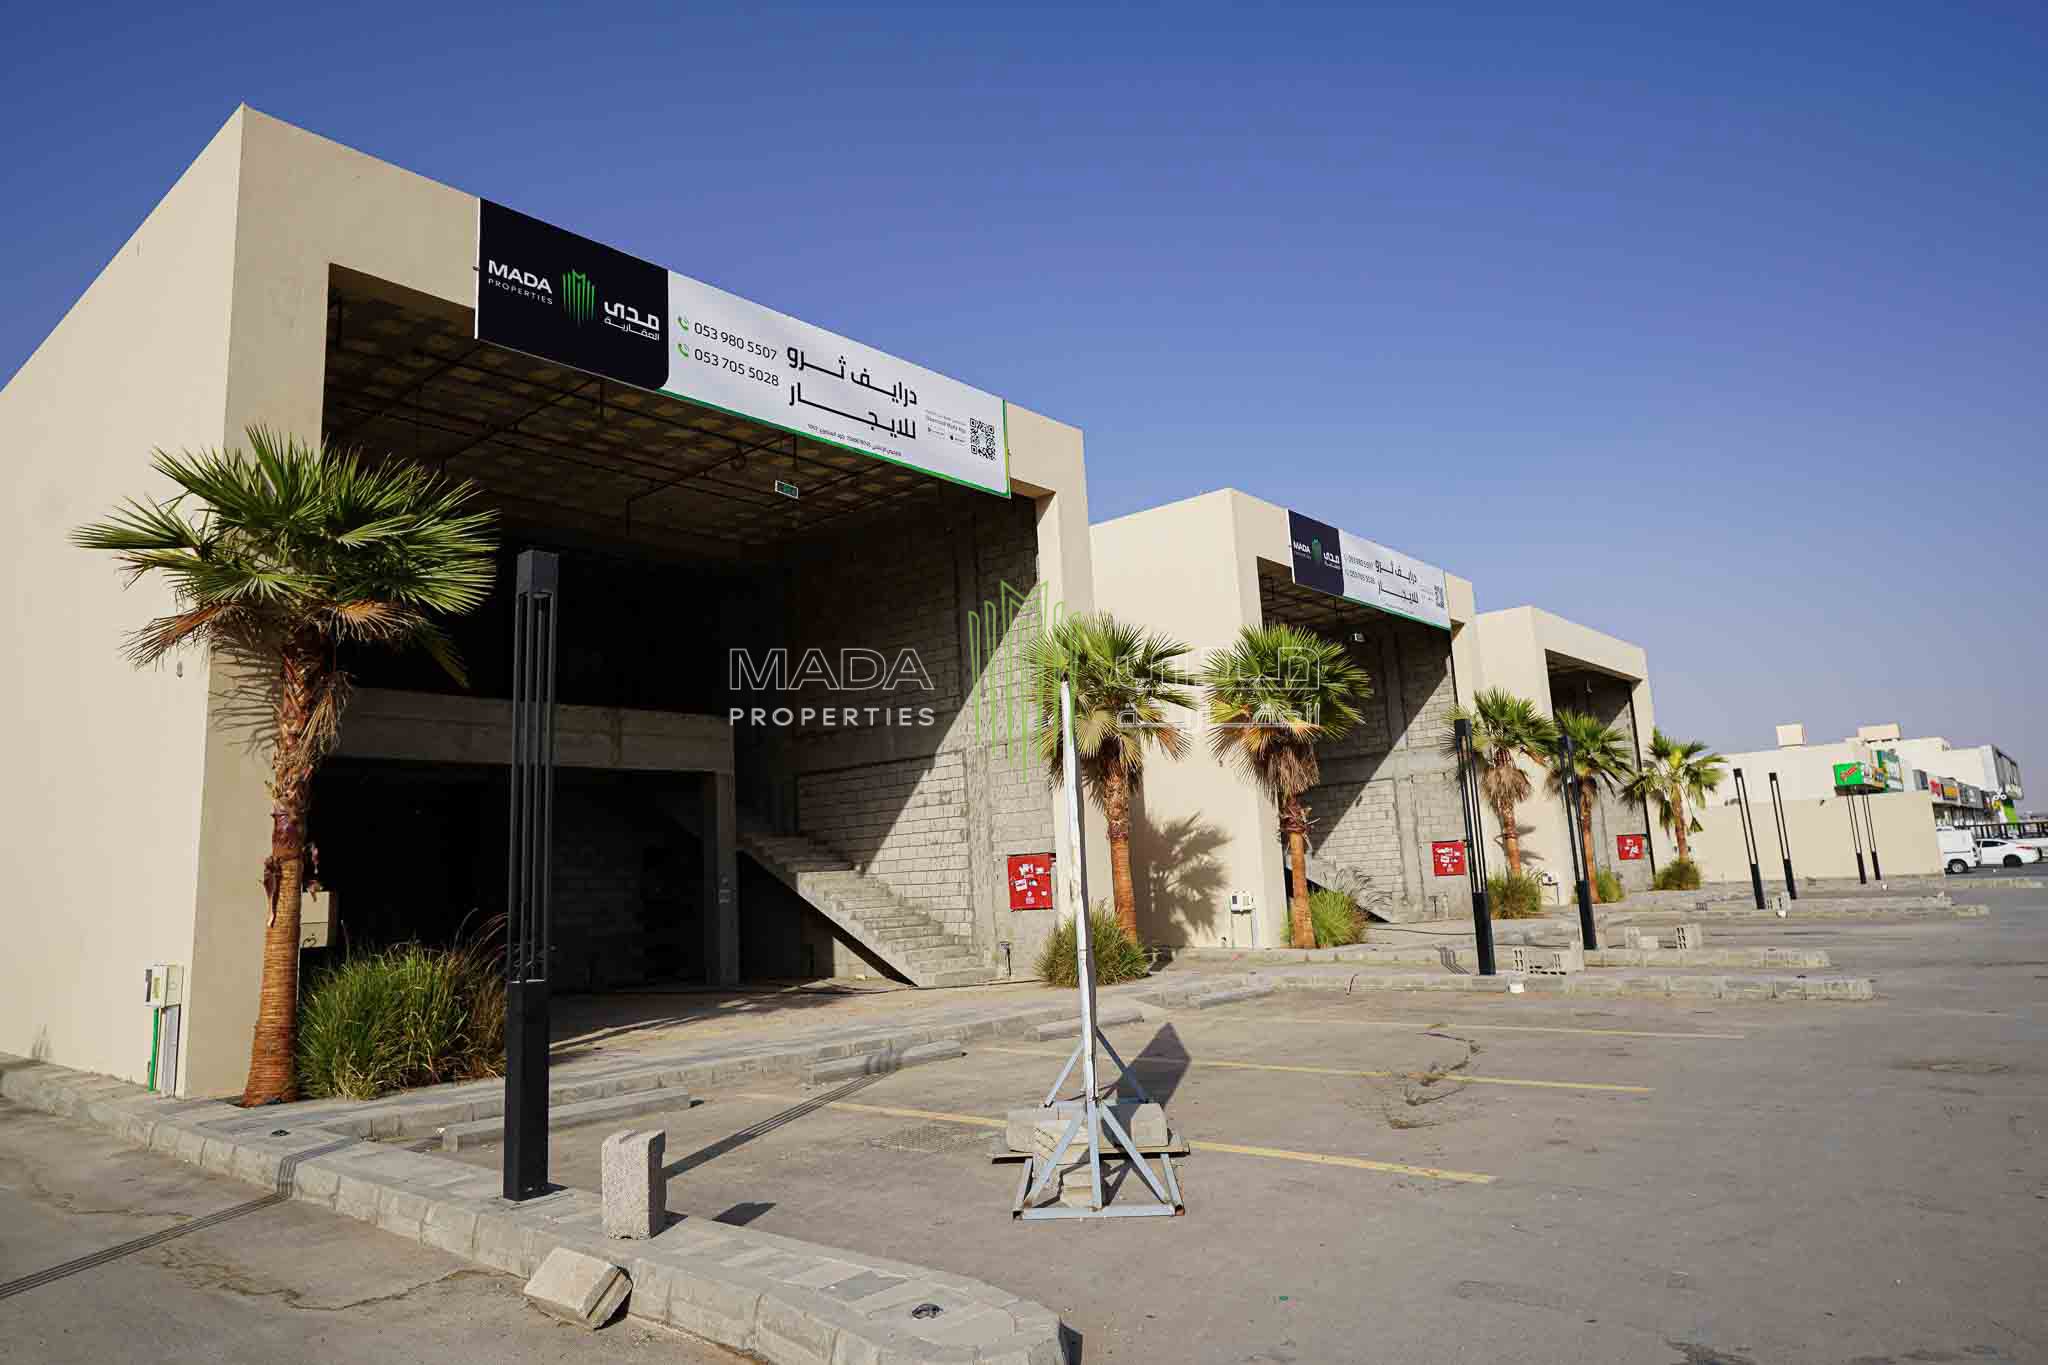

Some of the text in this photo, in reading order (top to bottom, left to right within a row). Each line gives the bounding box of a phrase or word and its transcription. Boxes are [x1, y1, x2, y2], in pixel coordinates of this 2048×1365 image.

[487, 278, 553, 306] PROPERTIES
[488, 259, 553, 295] MADA
[603, 300, 660, 332] مدى
[603, 316, 660, 342] العقارية
[694, 322, 778, 361] 053 980 5507
[694, 348, 780, 387] 053 705 5028
[786, 345, 918, 408] درايف ثرو
[788, 381, 917, 440] للايجار
